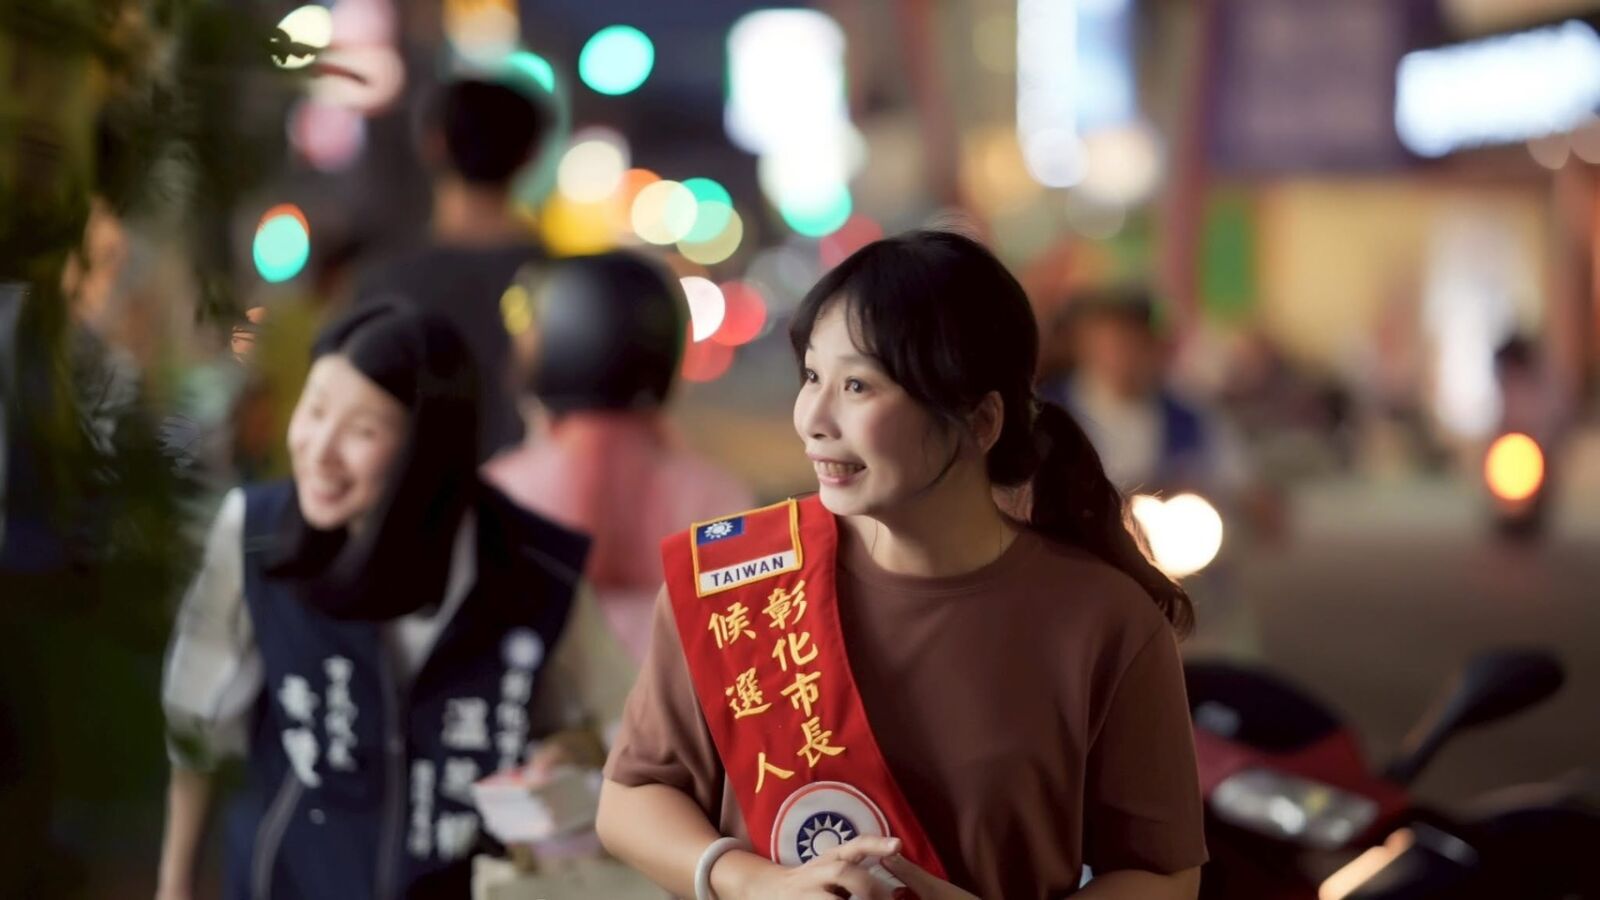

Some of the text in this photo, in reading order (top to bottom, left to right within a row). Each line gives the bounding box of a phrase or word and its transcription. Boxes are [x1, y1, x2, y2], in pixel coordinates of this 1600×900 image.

[711, 555, 785, 587] TAIWAN
[708, 602, 795, 793] 候選人
[761, 579, 846, 768] 彰化市長
